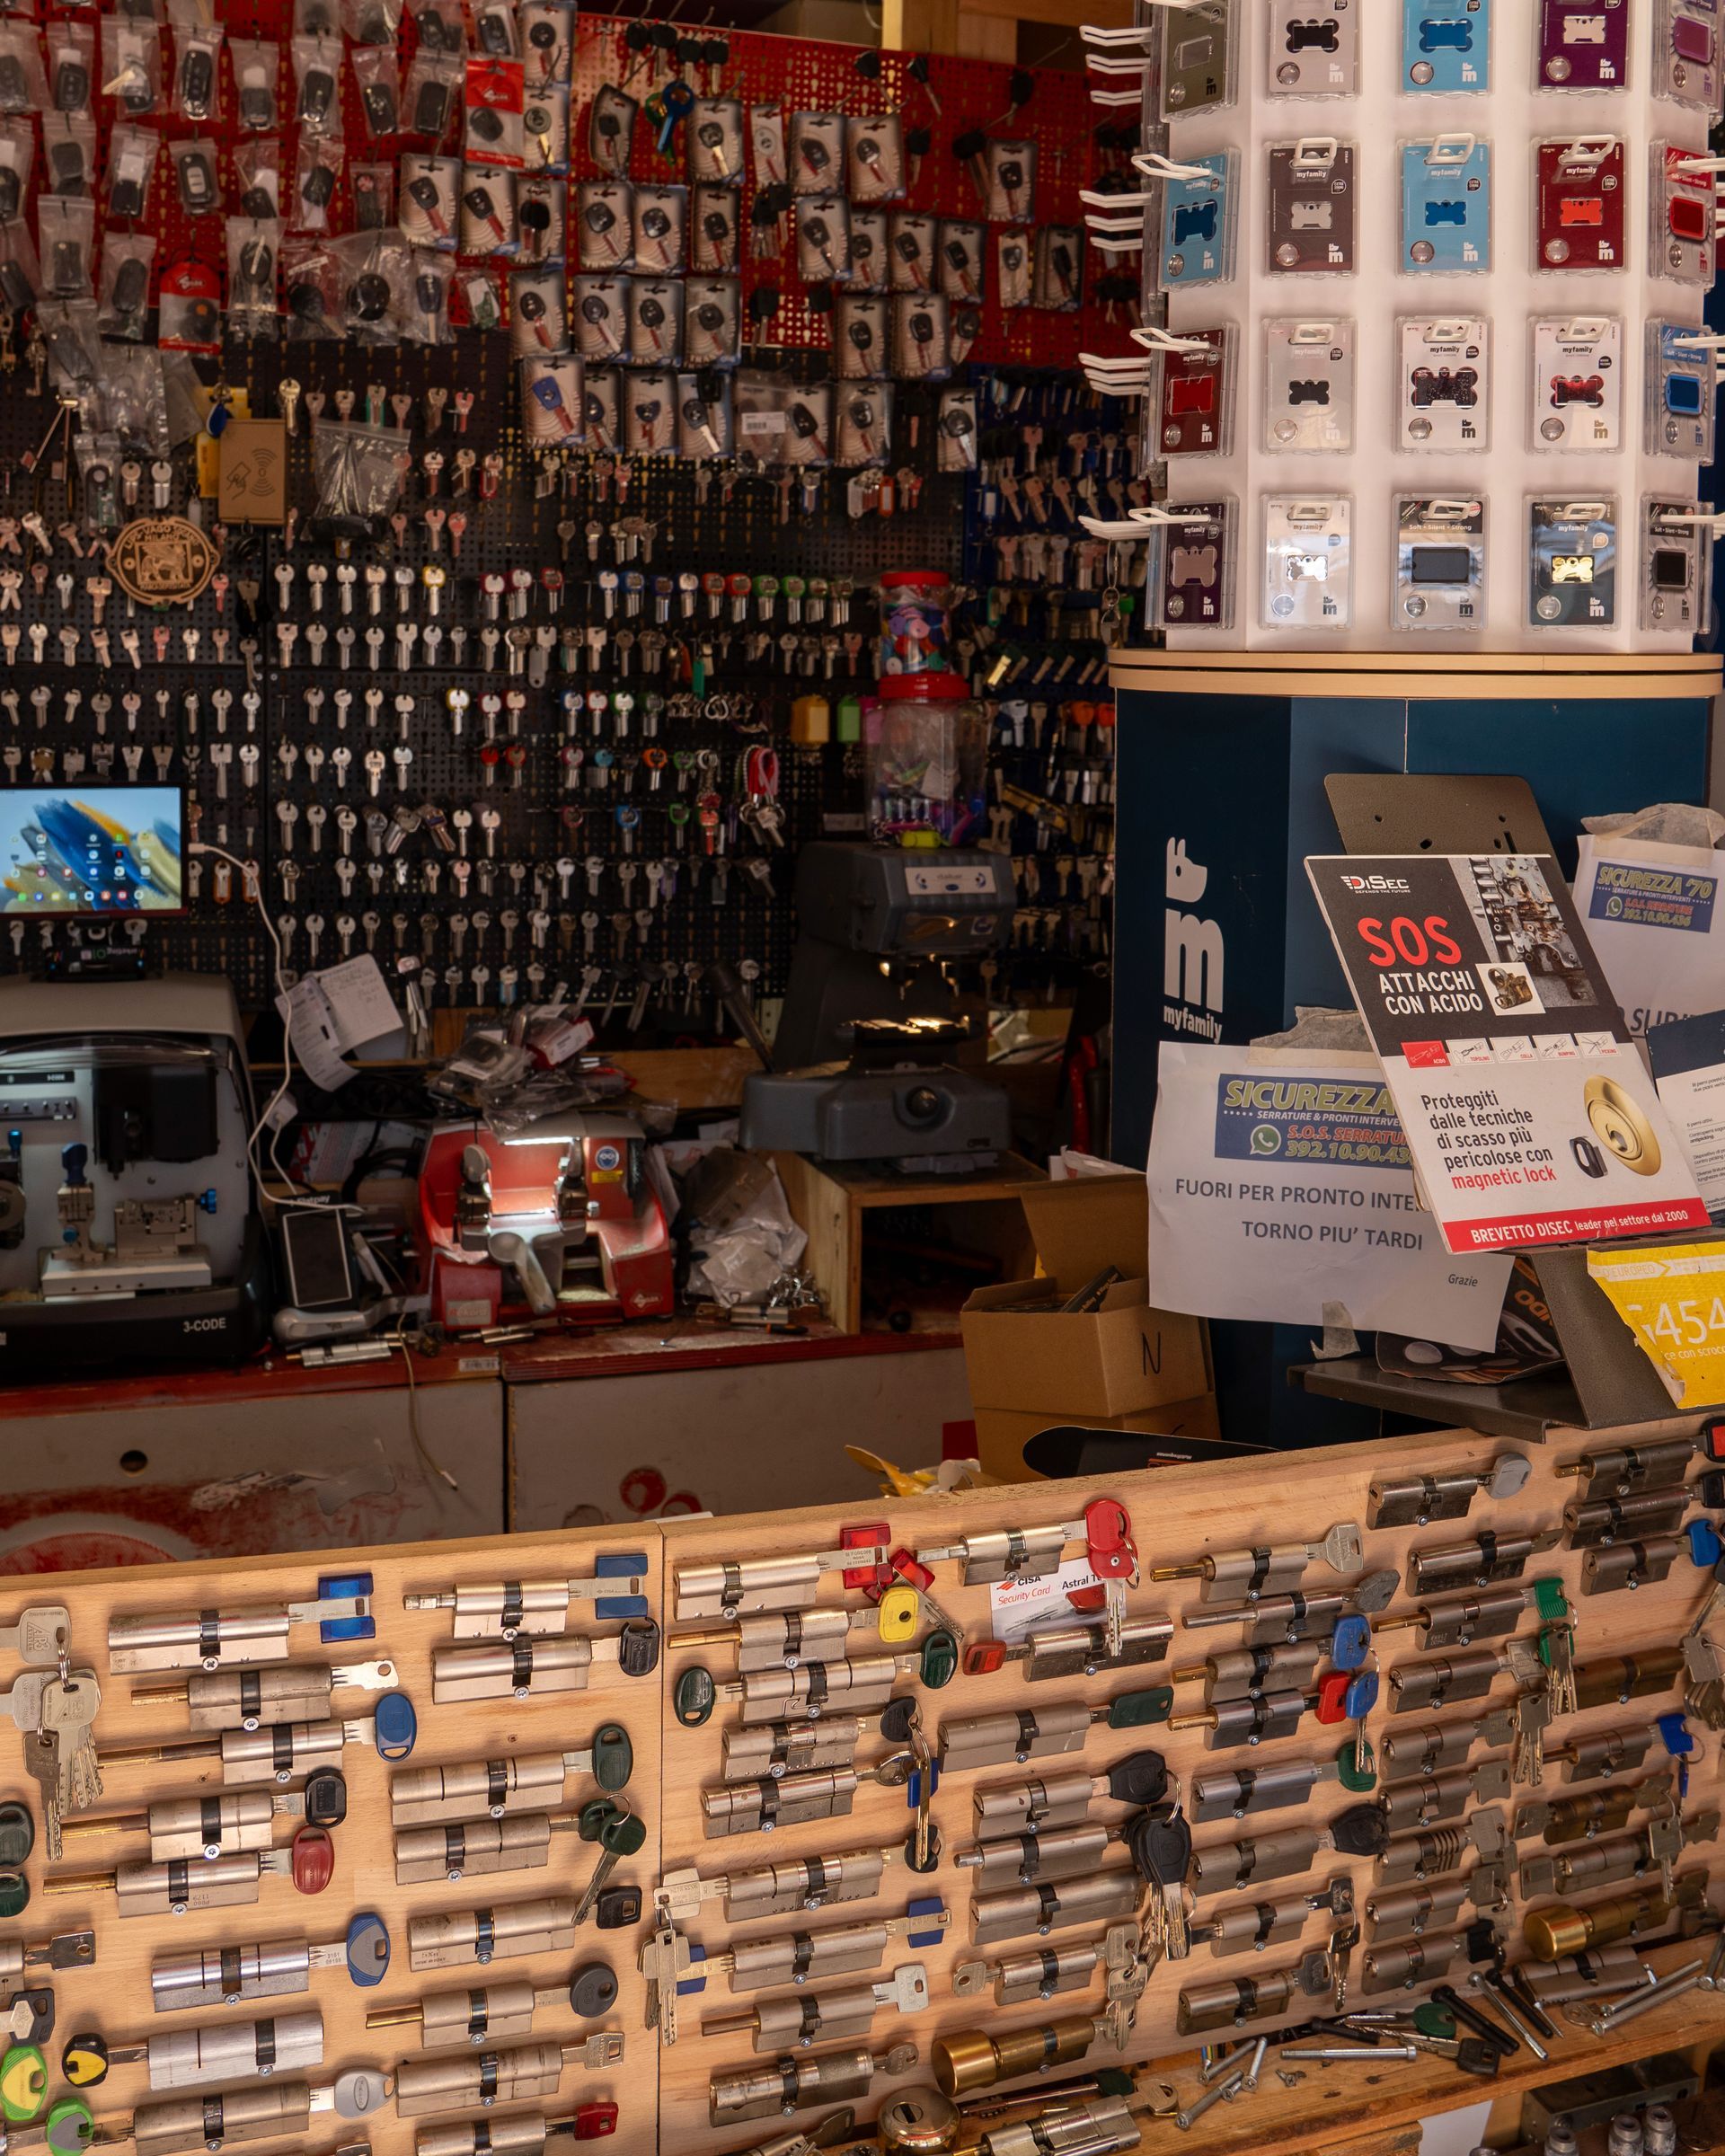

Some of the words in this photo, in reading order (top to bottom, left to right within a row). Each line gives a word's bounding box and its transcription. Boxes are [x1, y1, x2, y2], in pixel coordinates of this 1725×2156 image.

[1296, 170, 1327, 180] myfamily
[1430, 167, 1462, 177] myfamily
[1566, 166, 1597, 176] myfamily
[1429, 346, 1460, 356] myfamily
[1562, 346, 1593, 356] myfamily
[1451, 524, 1472, 533] Strong
[1558, 524, 1588, 534] myfamily
[1597, 866, 1683, 896] SICUREZZA
[1612, 887, 1638, 897] SERRATURE
[1358, 915, 1462, 968] SOS
[1379, 970, 1476, 994] ATTACCHI
[1385, 995, 1426, 1016] CON
[1430, 993, 1483, 1013] ACIDO
[1163, 1005, 1223, 1045] myfamily
[1224, 1080, 1396, 1117] SICUREZZA
[1420, 1090, 1499, 1111] Proteggiti
[1257, 1110, 1312, 1122] SERRATURE
[1313, 1112, 1322, 1122] &
[1322, 1113, 1358, 1124] PRONTI
[1359, 1116, 1402, 1127] INTERVE
[1429, 1112, 1466, 1130] dalle
[1469, 1108, 1534, 1127] tecniche
[1287, 1125, 1331, 1140] S.O.S.
[1437, 1133, 1452, 1150] di
[1455, 1130, 1506, 1148] scasso
[1509, 1126, 1533, 1147] più
[1444, 1149, 1522, 1172] pericolose
[1526, 1147, 1553, 1162] con
[1451, 1169, 1522, 1191] magnetic
[1525, 1165, 1557, 1183] lock
[1175, 1178, 1233, 1200] FUORI
[1239, 1183, 1275, 1203] PER
[1280, 1187, 1365, 1208] PRONTO
[1243, 1221, 1314, 1242] TORNO
[1364, 1229, 1423, 1251] TARDI
[1470, 1224, 1535, 1243] BREVETTO
[1536, 1220, 1573, 1238] DISEC
[1574, 1219, 1602, 1231] leader
[1604, 1218, 1618, 1229] nel
[1619, 1215, 1650, 1227] settore
[1651, 1213, 1665, 1224] dal
[1666, 1209, 1689, 1222] 2000
[1447, 1273, 1479, 1287] Grazie
[1612, 1264, 1655, 1277] EUROPEO
[182, 1317, 226, 1333] 3-CODE
[1142, 1331, 1161, 1376] N
[1678, 1349, 1696, 1359] con
[1018, 1575, 1042, 1586] CISA
[1062, 1574, 1089, 1590] Astral
[998, 1591, 1030, 1605] Security
[1031, 1585, 1051, 1596] Card
